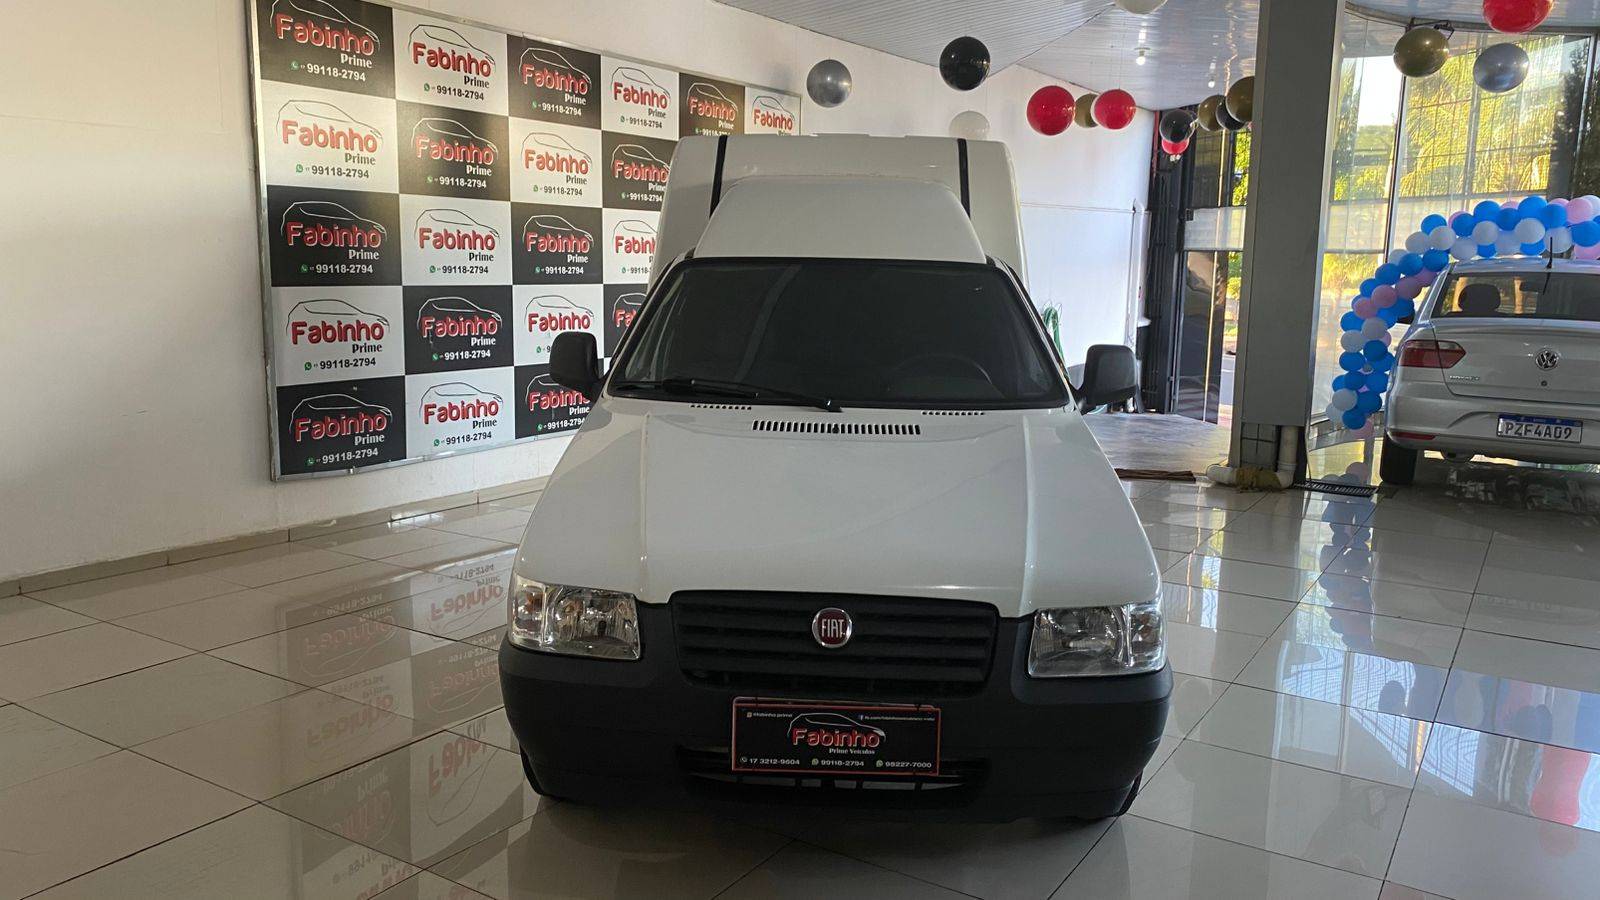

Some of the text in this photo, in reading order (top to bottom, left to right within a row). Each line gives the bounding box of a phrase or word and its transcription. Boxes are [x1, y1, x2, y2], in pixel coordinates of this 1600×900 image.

[275, 13, 375, 56] Fabinho
[340, 53, 373, 69] Prime
[412, 41, 492, 77] Fabinho
[306, 63, 366, 82] 99118-2794
[521, 63, 590, 96] Fabinho
[463, 75, 490, 89] Prime
[436, 85, 485, 101] 99118-2794
[564, 93, 587, 106] Prime
[613, 81, 668, 109] Fabinho
[541, 103, 582, 117] 99118-2794
[648, 108, 667, 119] Prime
[687, 96, 737, 122] Fabinho
[753, 108, 793, 131] Fabinho
[282, 119, 378, 153] Fabinho
[415, 133, 494, 165] Fabinho
[344, 152, 376, 166] Prime
[523, 148, 590, 175] Fabinho
[311, 165, 370, 179] 99118-2794
[466, 164, 492, 177] Prime
[612, 158, 669, 183] Fabinho
[439, 175, 487, 188] 99118-2794
[566, 174, 588, 185] Prime
[543, 185, 583, 196] 99118-2794
[286, 220, 382, 248] Fabinho
[418, 227, 496, 251] Fabinho
[526, 231, 591, 254] Fabinho
[615, 235, 656, 255] Fabinh
[348, 249, 380, 260] Prime
[468, 251, 495, 262] Prime
[567, 254, 590, 264] Prime
[316, 264, 374, 274] 99118-2794
[441, 265, 489, 274] 99118-2794
[544, 266, 585, 275] 99118-2794
[421, 314, 498, 339] Fabinho
[527, 311, 591, 333] Fabinho
[291, 319, 385, 345] Fabinho
[352, 342, 383, 354] Prime
[470, 336, 497, 347] Prime
[444, 349, 491, 361] 99118-2794
[319, 357, 377, 370] 99118-2794
[528, 390, 591, 412] Fabinh
[423, 399, 500, 425] Fabinho
[569, 405, 591, 416] Prime
[294, 411, 388, 443] Fabinho
[472, 419, 498, 430] Prime
[1504, 420, 1573, 440] PZF4A09
[354, 433, 386, 446] Prime
[445, 431, 493, 446] 99118-2794
[322, 447, 379, 465] 99118-2794
[821, 618, 845, 638] FIAT
[792, 727, 881, 749] Fabinho
[828, 747, 847, 755] Prime
[749, 757, 758, 765] 17
